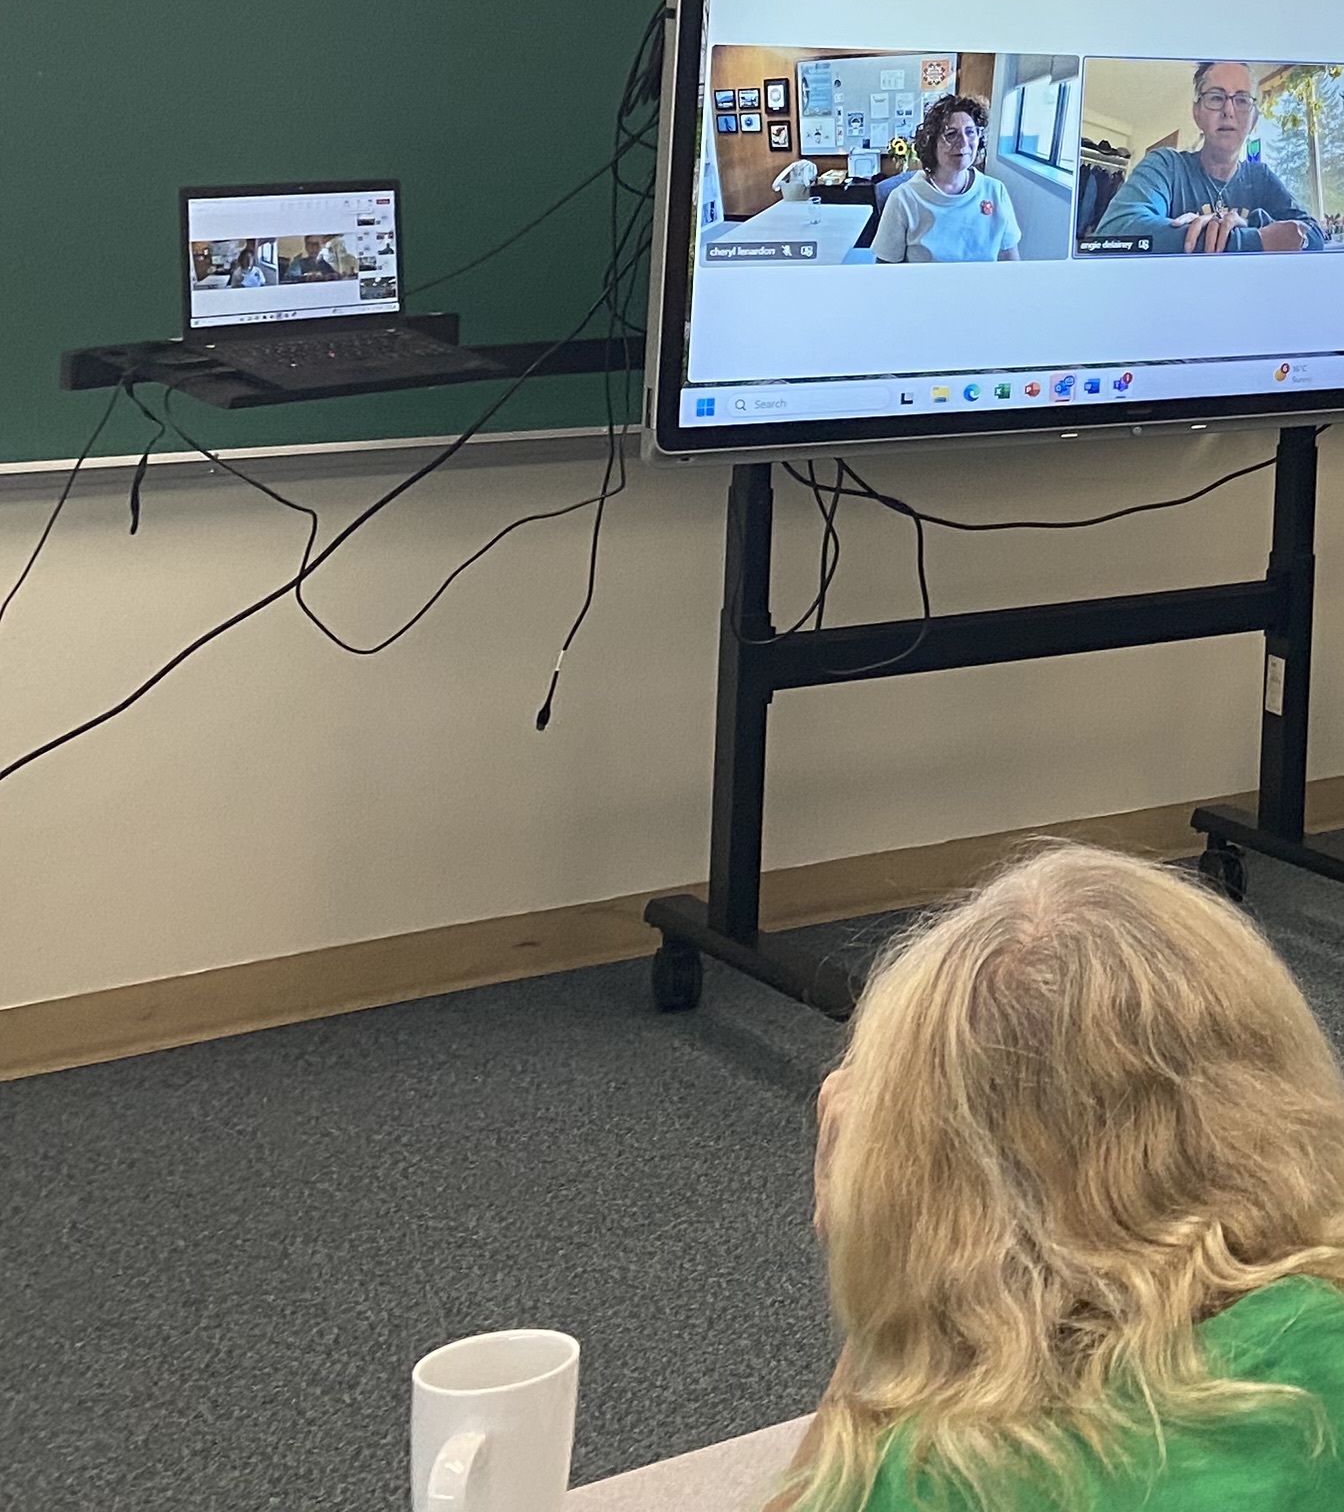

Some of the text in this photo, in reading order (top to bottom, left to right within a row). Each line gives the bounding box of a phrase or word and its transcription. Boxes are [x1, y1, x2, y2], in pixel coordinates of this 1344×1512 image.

[1080, 240, 1102, 251] angie
[709, 246, 736, 257] cheryl
[754, 398, 787, 409] Search
